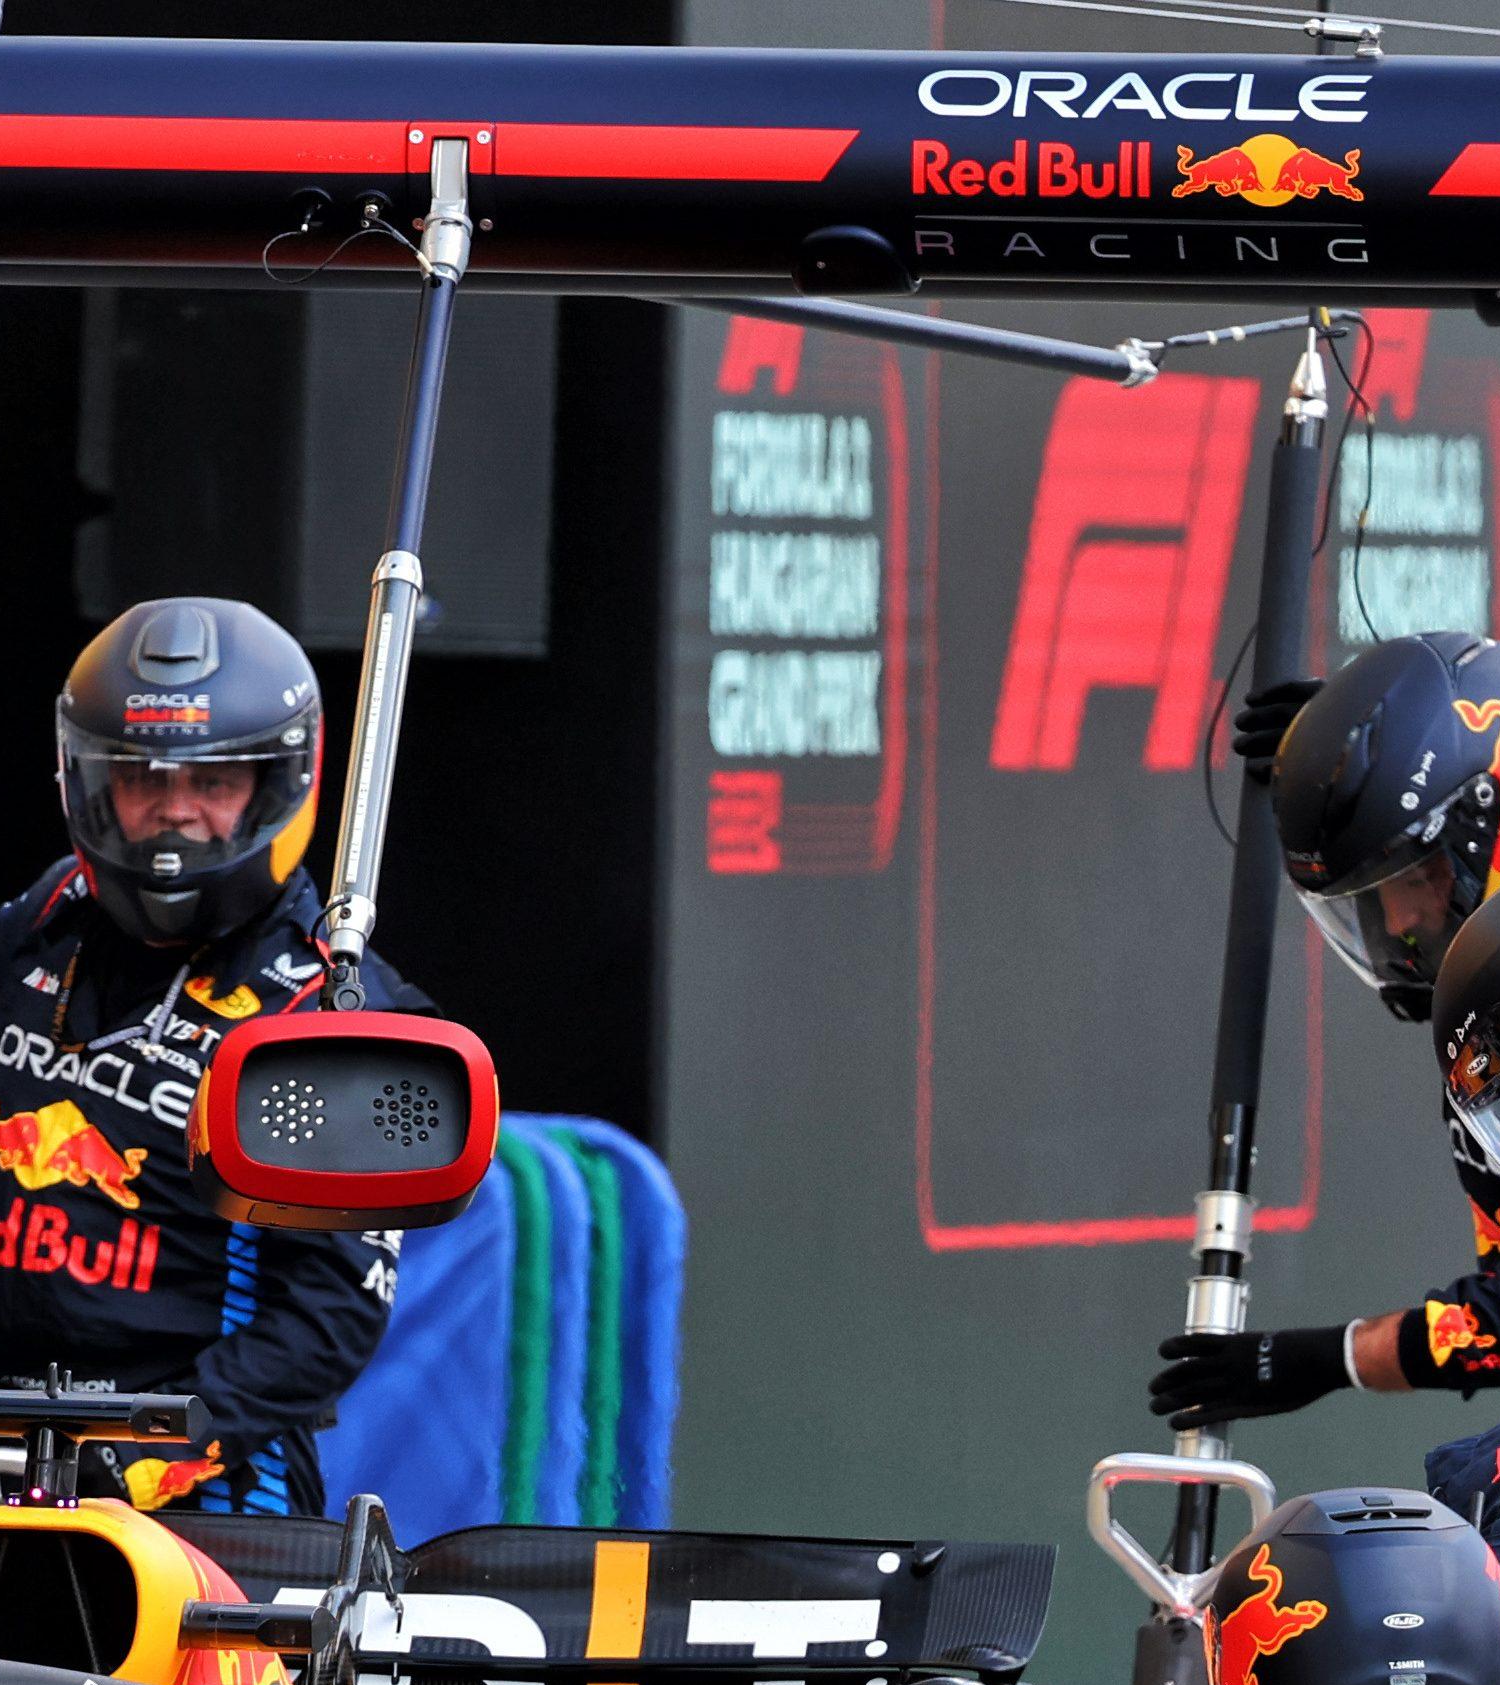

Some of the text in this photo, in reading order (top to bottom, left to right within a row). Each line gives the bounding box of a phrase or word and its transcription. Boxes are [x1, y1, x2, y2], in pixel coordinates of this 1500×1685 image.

[918, 69, 1369, 122] ORACLE
[911, 138, 1152, 200] Red Bull
[914, 229, 1370, 263] RACING
[125, 693, 210, 709] ORACLE
[22, 1203, 160, 1292] Bull
[1387, 1615, 1420, 1627] HJC
[1389, 1660, 1425, 1670] T.SMITH
